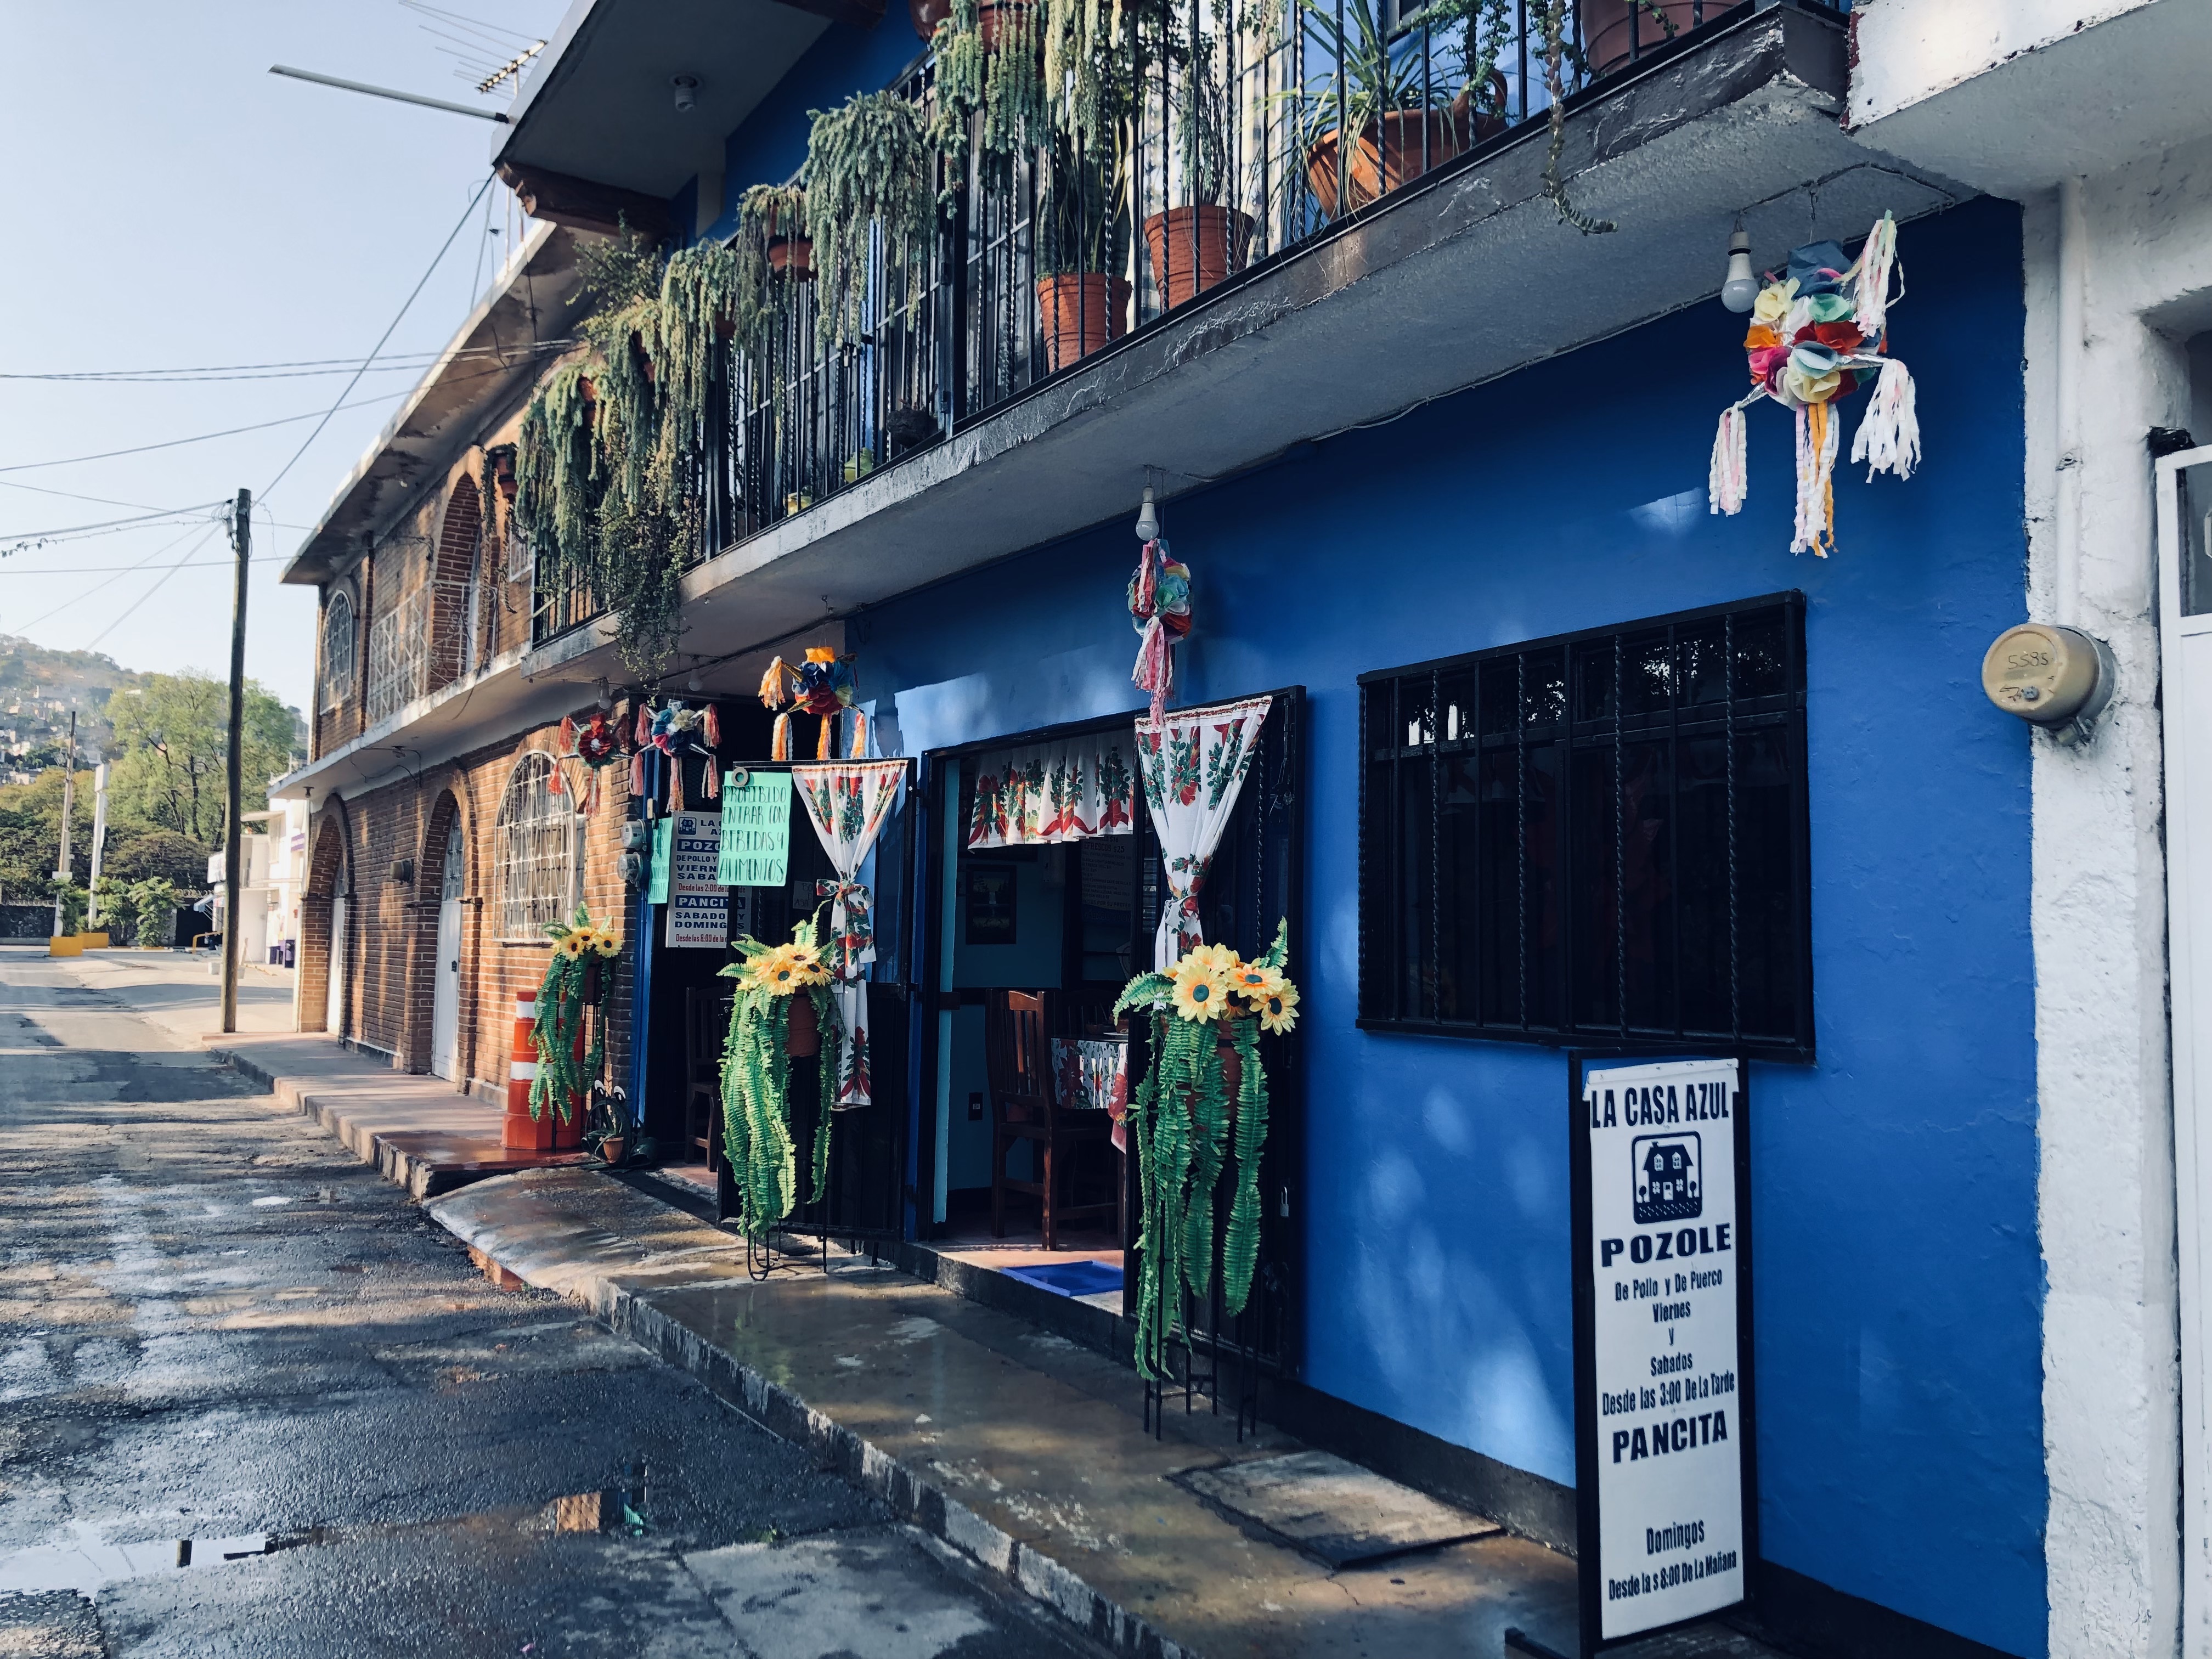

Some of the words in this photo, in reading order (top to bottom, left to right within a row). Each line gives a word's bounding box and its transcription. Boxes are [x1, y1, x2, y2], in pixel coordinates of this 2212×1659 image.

[723, 786, 787, 804] PROHIBIDO
[723, 805, 764, 825] ENTRAR
[769, 805, 786, 823] CON
[681, 841, 720, 851] POZO
[721, 830, 774, 853] BEBIDAS
[1113, 845, 1125, 854] $25
[676, 864, 717, 872] VIERN
[719, 857, 785, 883] ALIMENTOS
[678, 883, 695, 891] Desde
[704, 884, 717, 892] 2:00
[675, 921, 744, 929] DOMINGS
[676, 934, 691, 942] Desde
[700, 934, 712, 943] 8:00
[713, 934, 719, 943] de
[719, 934, 724, 943] la
[1591, 1088, 1617, 1128] LA
[1624, 1085, 1680, 1126] CASA
[1685, 1081, 1730, 1121] AZUL
[1600, 1222, 1731, 1268] POZOLE
[1615, 1281, 1629, 1302] De
[1633, 1277, 1658, 1300] Pollo
[1674, 1272, 1687, 1294] De
[1690, 1268, 1723, 1290] Puerco
[1652, 1300, 1691, 1324] Viernes
[1650, 1351, 1693, 1378] Sabados
[1602, 1388, 1636, 1417] Desde
[1640, 1385, 1656, 1410] las
[1660, 1379, 1681, 1407] 3:00
[1685, 1377, 1697, 1402] De
[1698, 1374, 1709, 1398] La
[1710, 1369, 1735, 1396] Tarde
[1612, 1409, 1728, 1465] PANCITA
[1646, 1519, 1705, 1556] Domingos
[1609, 1573, 1640, 1601] Desde
[1660, 1566, 1680, 1590] 8:00
[1681, 1561, 1693, 1583] De
[1694, 1558, 1705, 1580] La
[1705, 1549, 1737, 1578] Mañana
